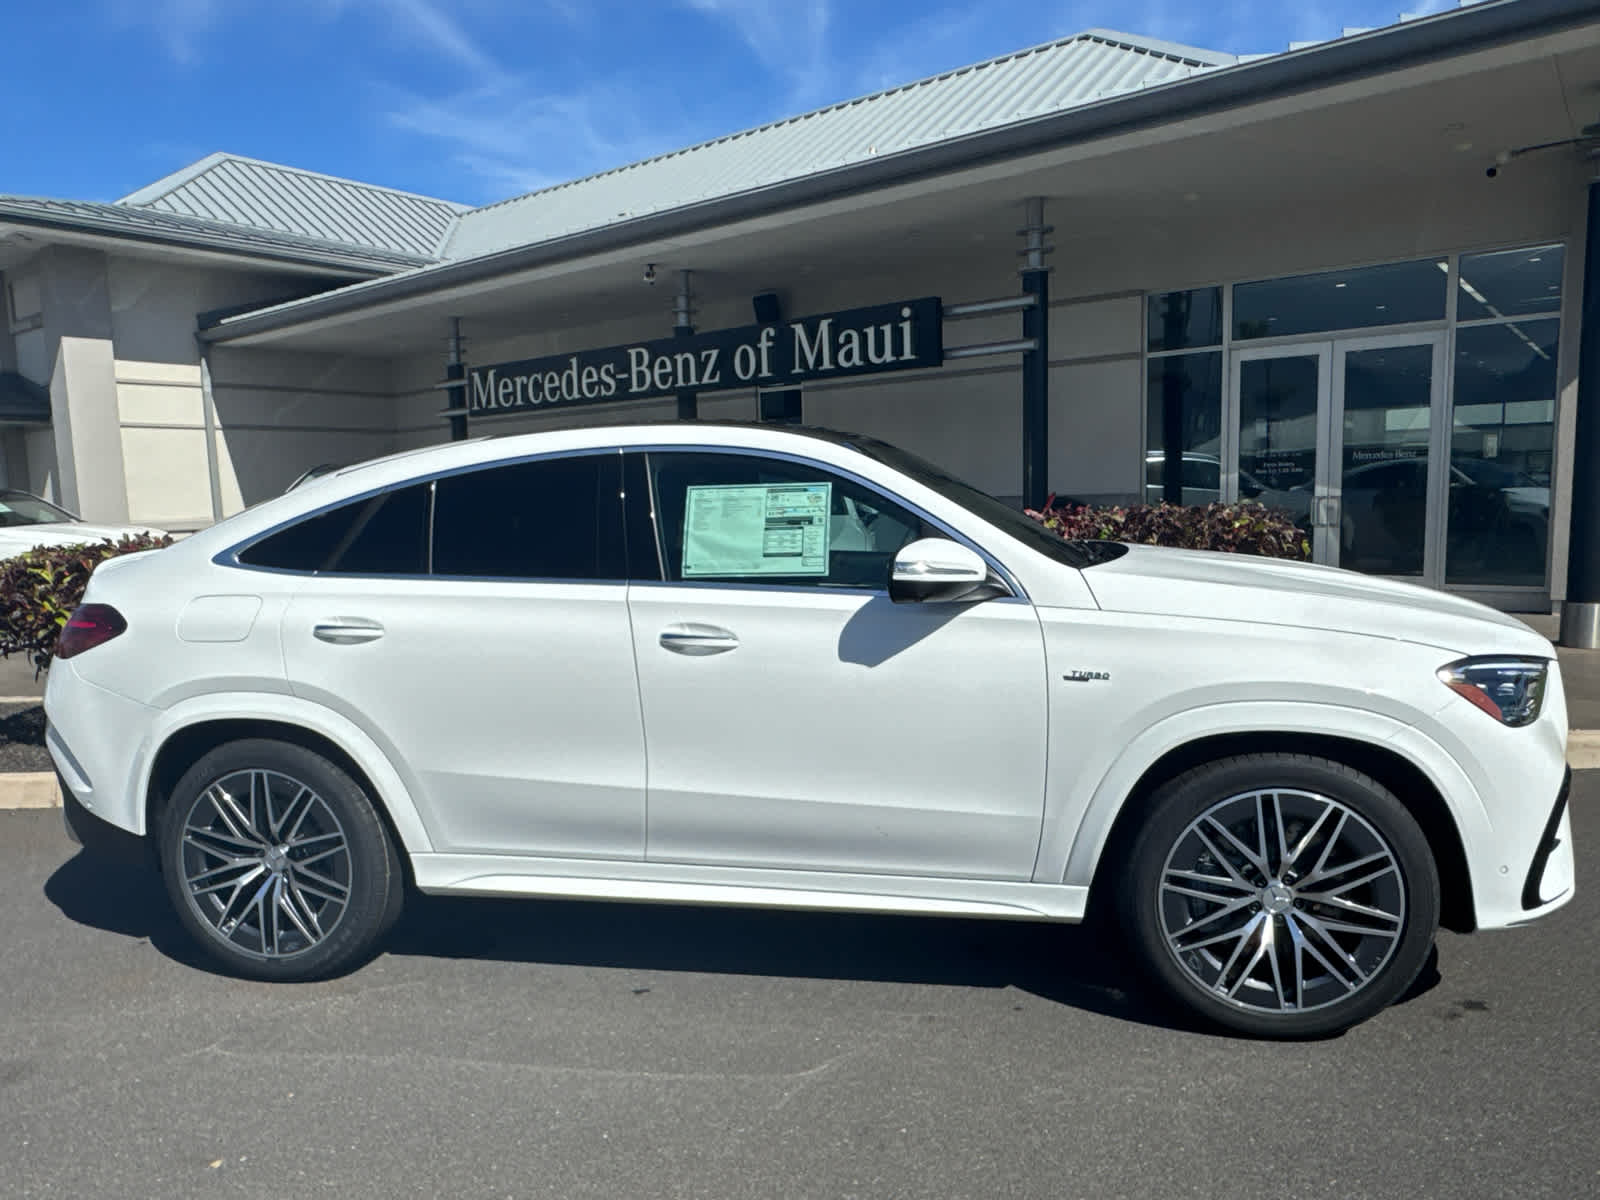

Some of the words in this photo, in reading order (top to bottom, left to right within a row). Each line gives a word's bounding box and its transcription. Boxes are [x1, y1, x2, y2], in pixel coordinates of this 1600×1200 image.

[471, 347, 721, 411] Mercedes-Benz
[734, 327, 776, 381] of
[790, 307, 917, 375] Maui
[1072, 670, 1111, 681] TURBO
